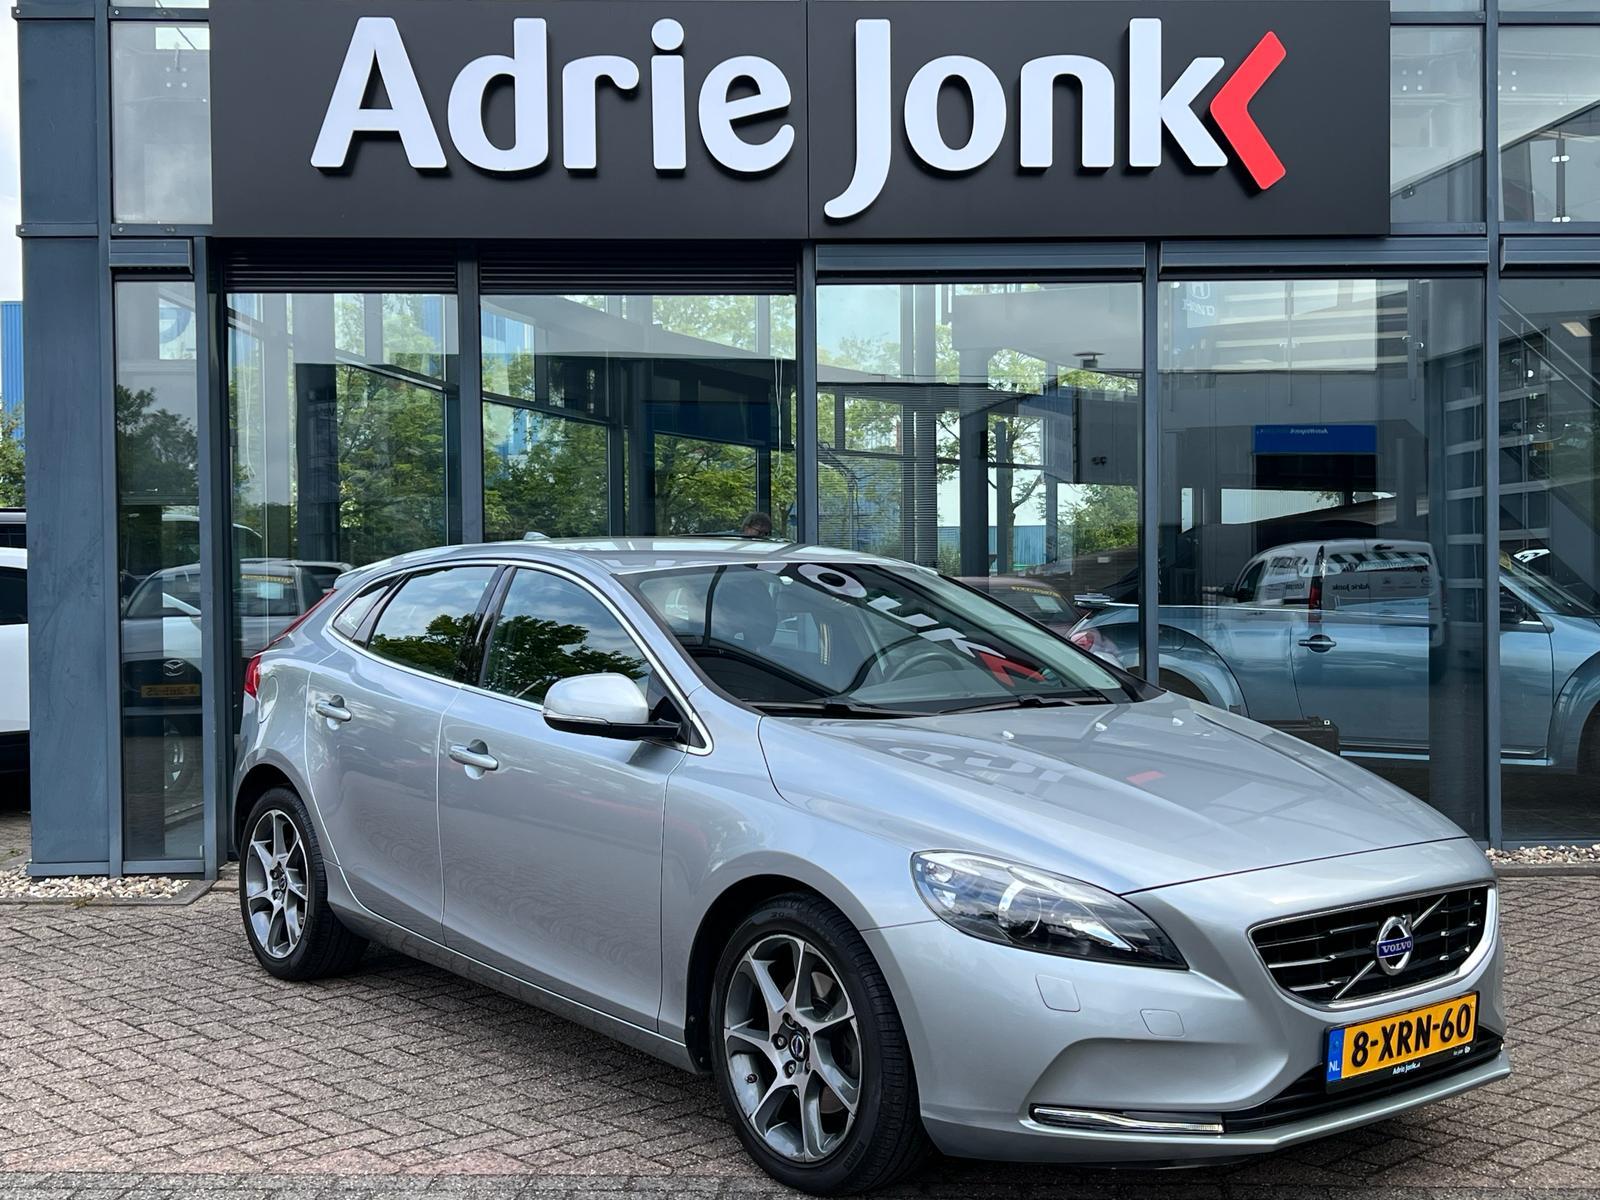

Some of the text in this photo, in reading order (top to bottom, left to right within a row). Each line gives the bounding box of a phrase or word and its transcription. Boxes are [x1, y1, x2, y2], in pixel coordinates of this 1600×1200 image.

[310, 17, 1229, 219] Adrie Jonk
[1381, 940, 1412, 954] VOLVO
[1351, 1003, 1471, 1068] 8-XRN-60
[1328, 1061, 1341, 1073] NL
